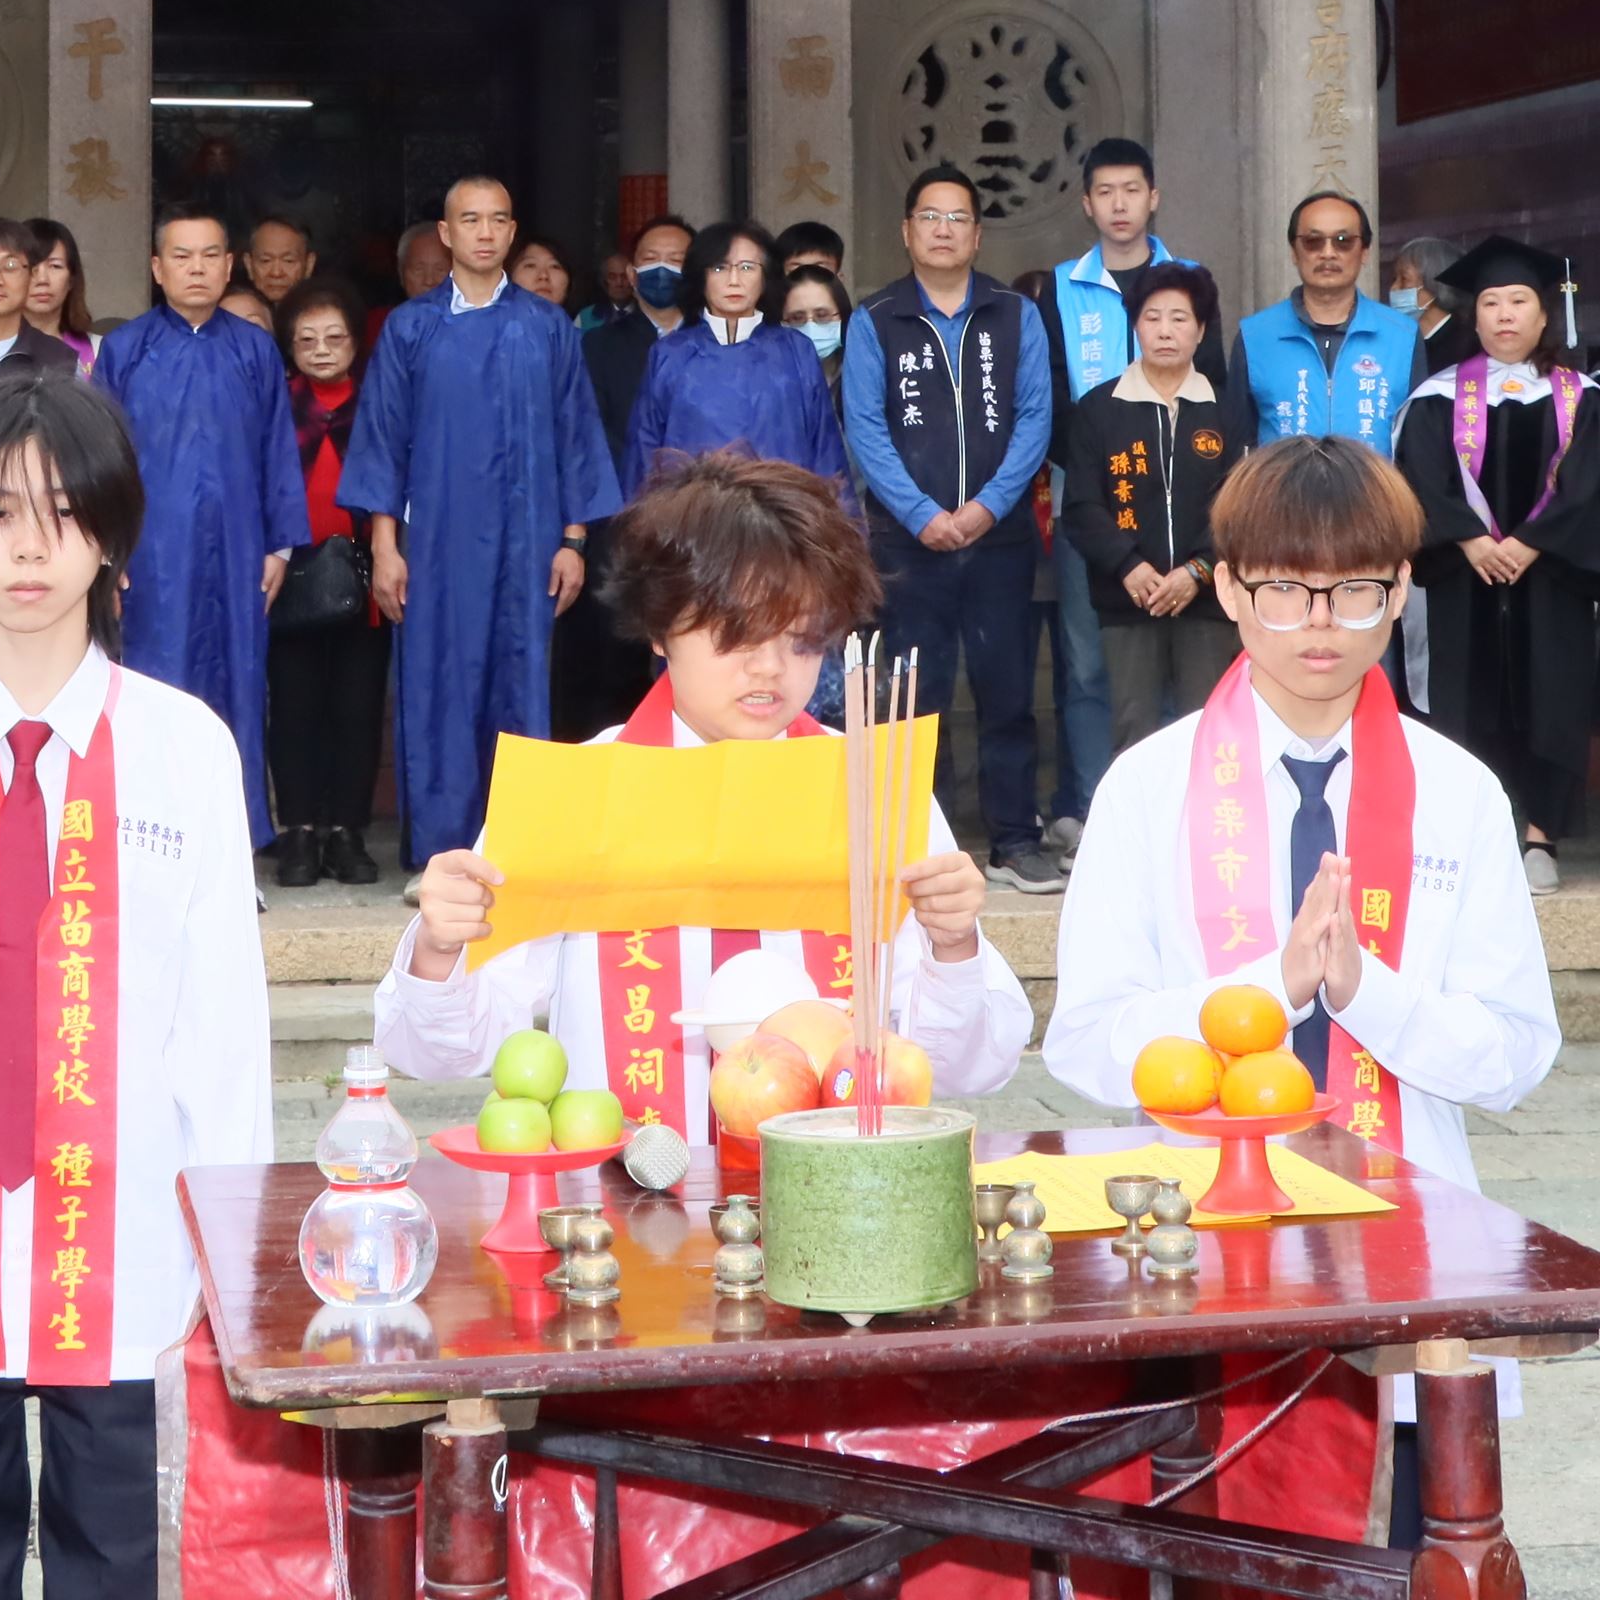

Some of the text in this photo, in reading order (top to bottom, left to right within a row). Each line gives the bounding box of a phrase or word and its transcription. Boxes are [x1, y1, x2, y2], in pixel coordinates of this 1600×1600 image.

[899, 351, 924, 427] 陳仁杰
[921, 342, 935, 370] 主席
[1358, 377, 1377, 450] 邱鎮軍
[116, 816, 185, 846] 立苗栗高商
[1209, 741, 1262, 962] 苗栗市文
[48, 798, 98, 1353] 國立苗商學校 種子學生
